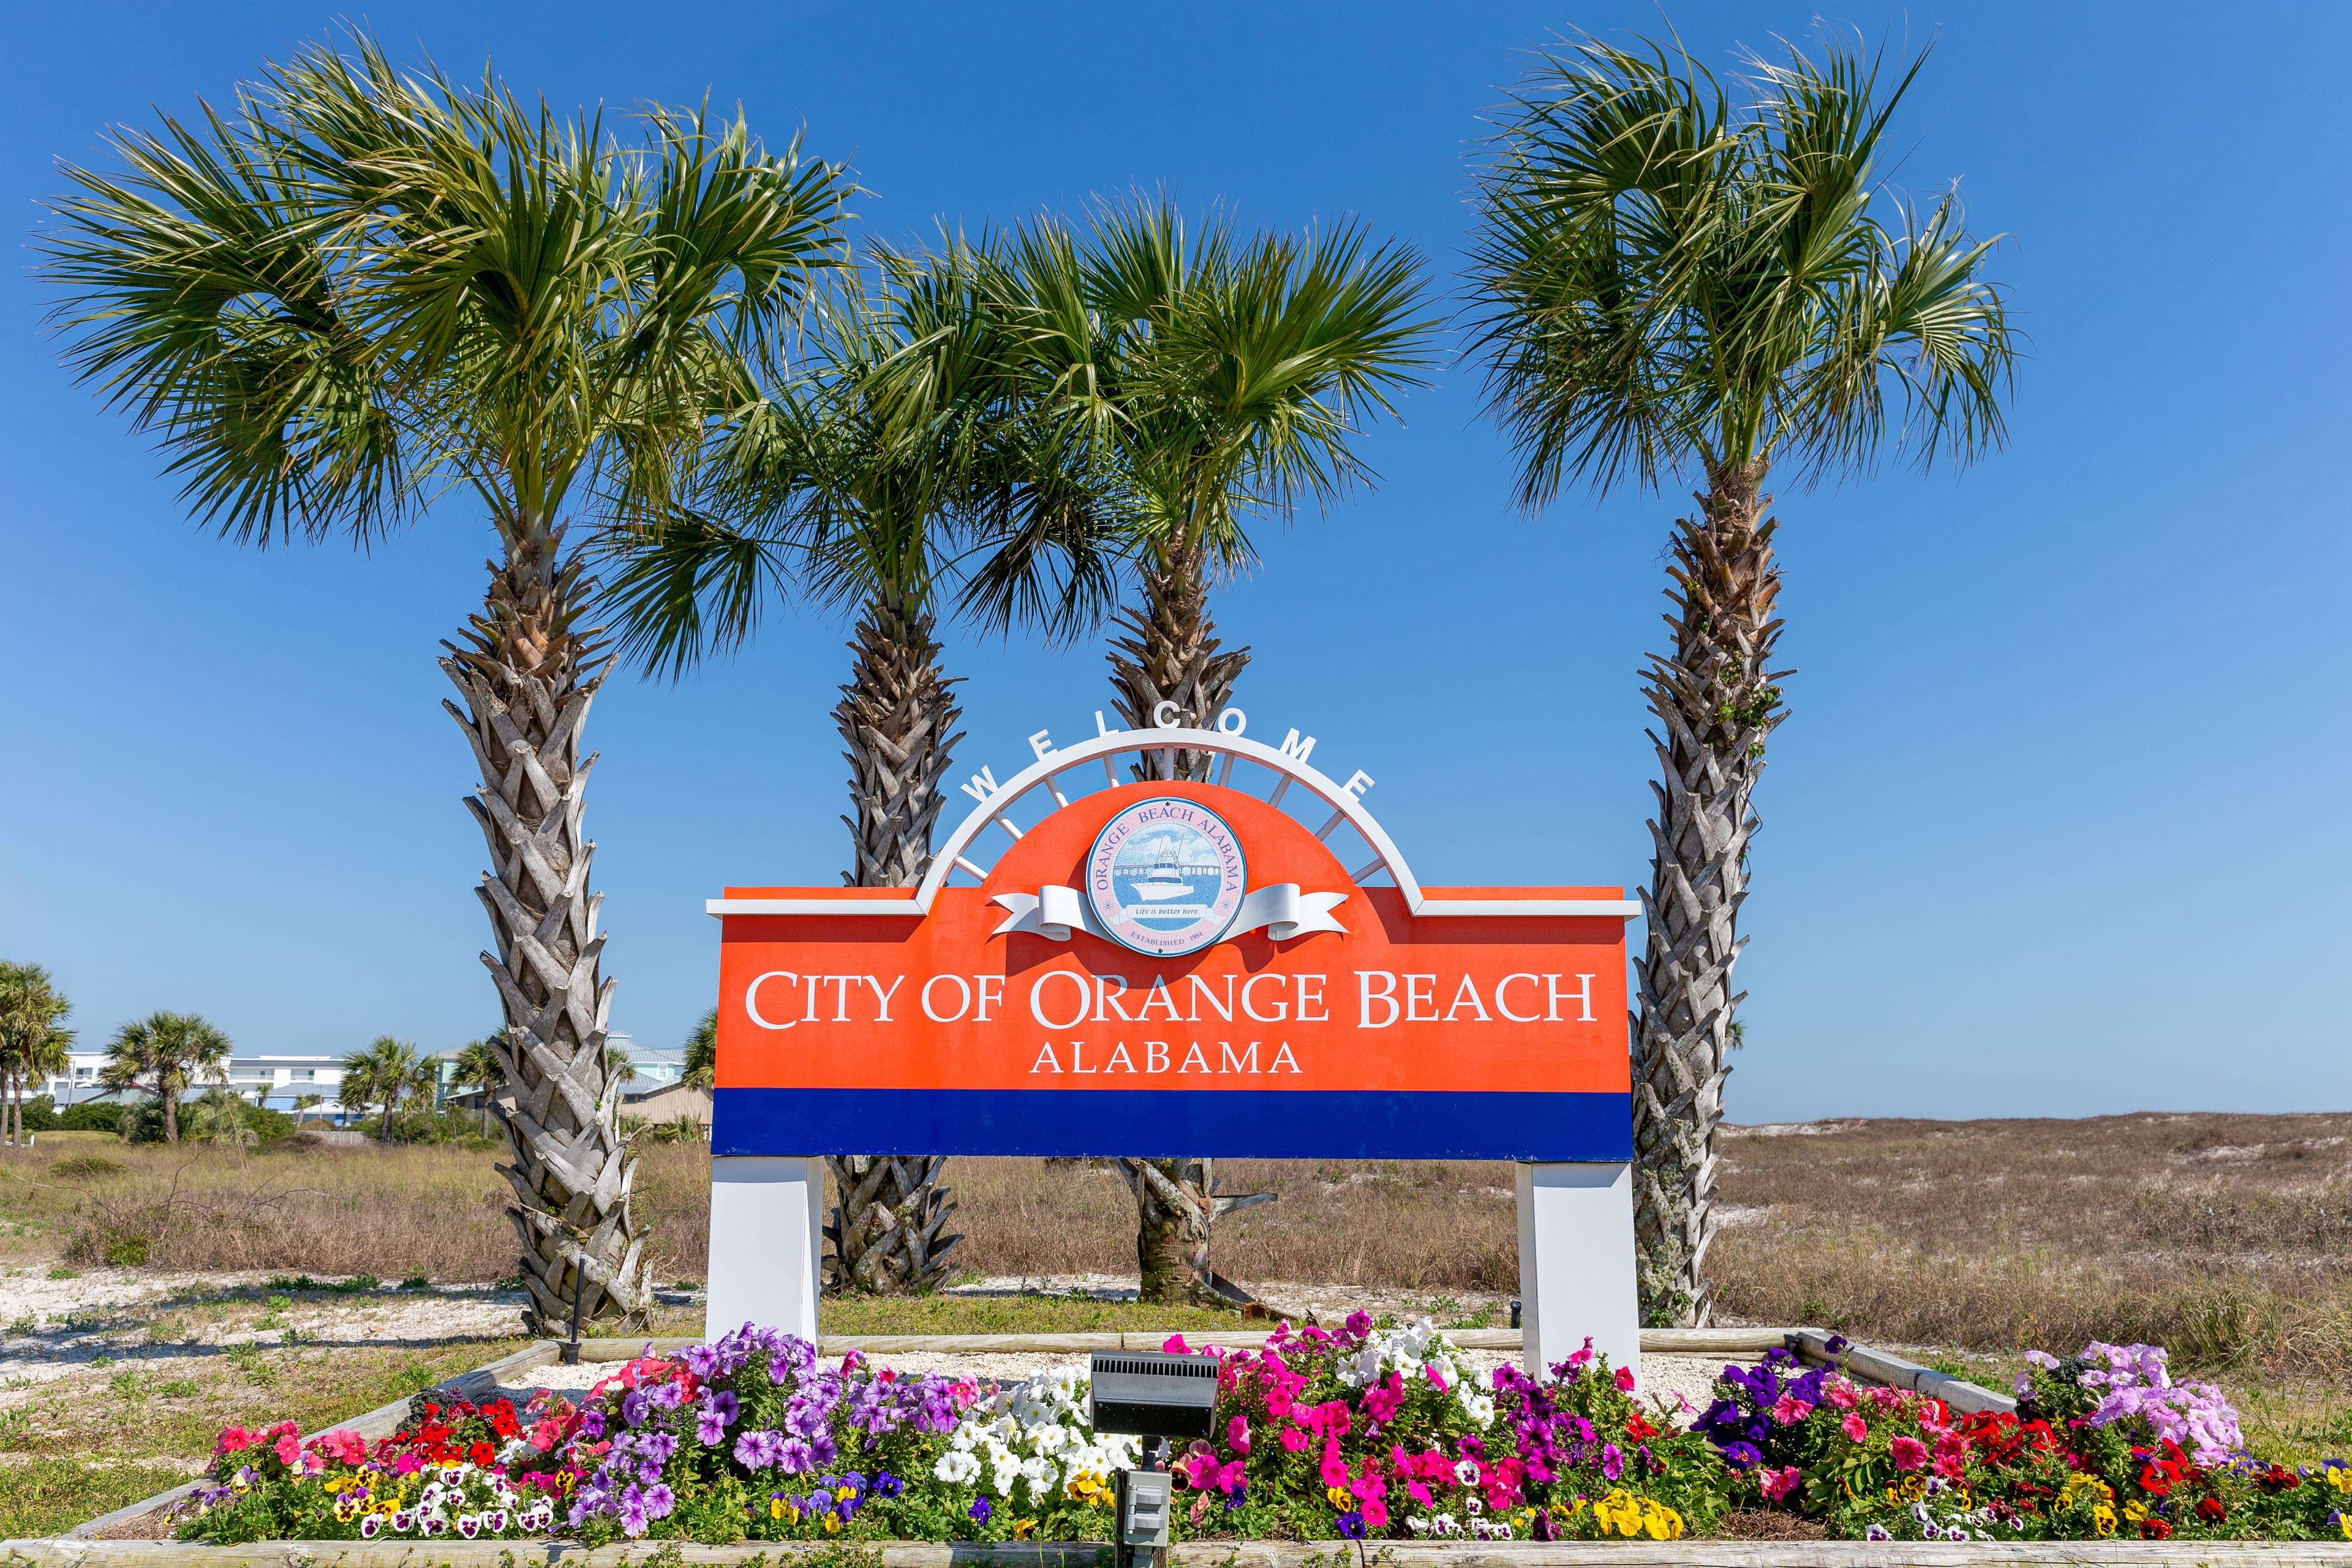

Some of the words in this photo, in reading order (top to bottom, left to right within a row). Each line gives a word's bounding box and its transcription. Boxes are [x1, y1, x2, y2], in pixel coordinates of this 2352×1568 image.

[960, 700, 1375, 803] WELCOME
[1096, 823, 1129, 891] ORANGE
[1138, 807, 1194, 824] BEACH
[1197, 818, 1238, 892] ALABAMA
[1131, 932, 1185, 946] ESTABLISHED
[1189, 932, 1203, 941] 1984
[745, 971, 905, 1030] CITY
[921, 974, 1006, 1023] OF
[1030, 970, 1329, 1030] ORANGE
[1353, 970, 1597, 1028] BEACH
[1029, 1041, 1303, 1074] ALABAMA
